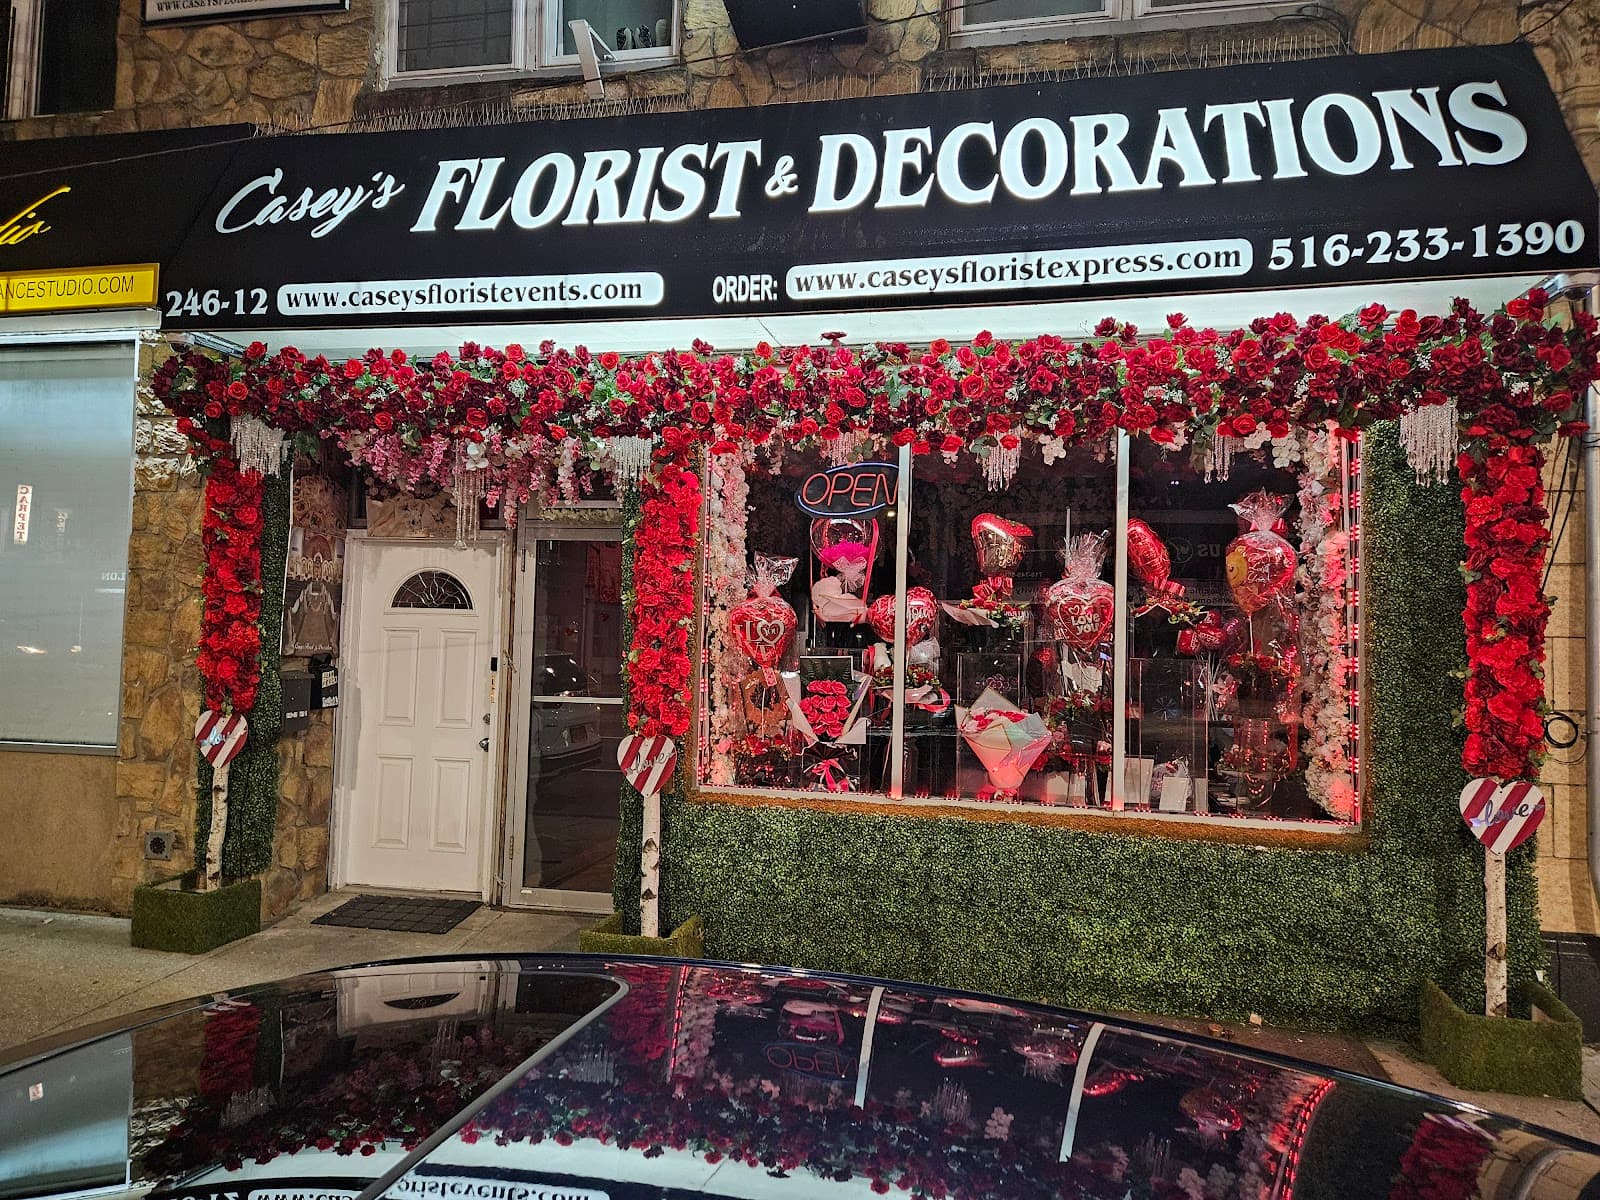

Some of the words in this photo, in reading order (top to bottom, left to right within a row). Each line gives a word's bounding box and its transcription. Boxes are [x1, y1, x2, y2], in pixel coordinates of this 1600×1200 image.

[215, 168, 405, 238] Casey's
[410, 140, 762, 233] FLORIST
[765, 155, 798, 197] &
[808, 80, 1529, 214] DECORATIONS
[1267, 220, 1586, 271] 516-233-1390
[795, 246, 1241, 293] www.caseysfloristexpress.com
[166, 288, 268, 317] 246-12
[286, 279, 643, 311] www.caseysfloristevents.com
[712, 275, 778, 302] ORDER:
[802, 473, 899, 507] OPEN
